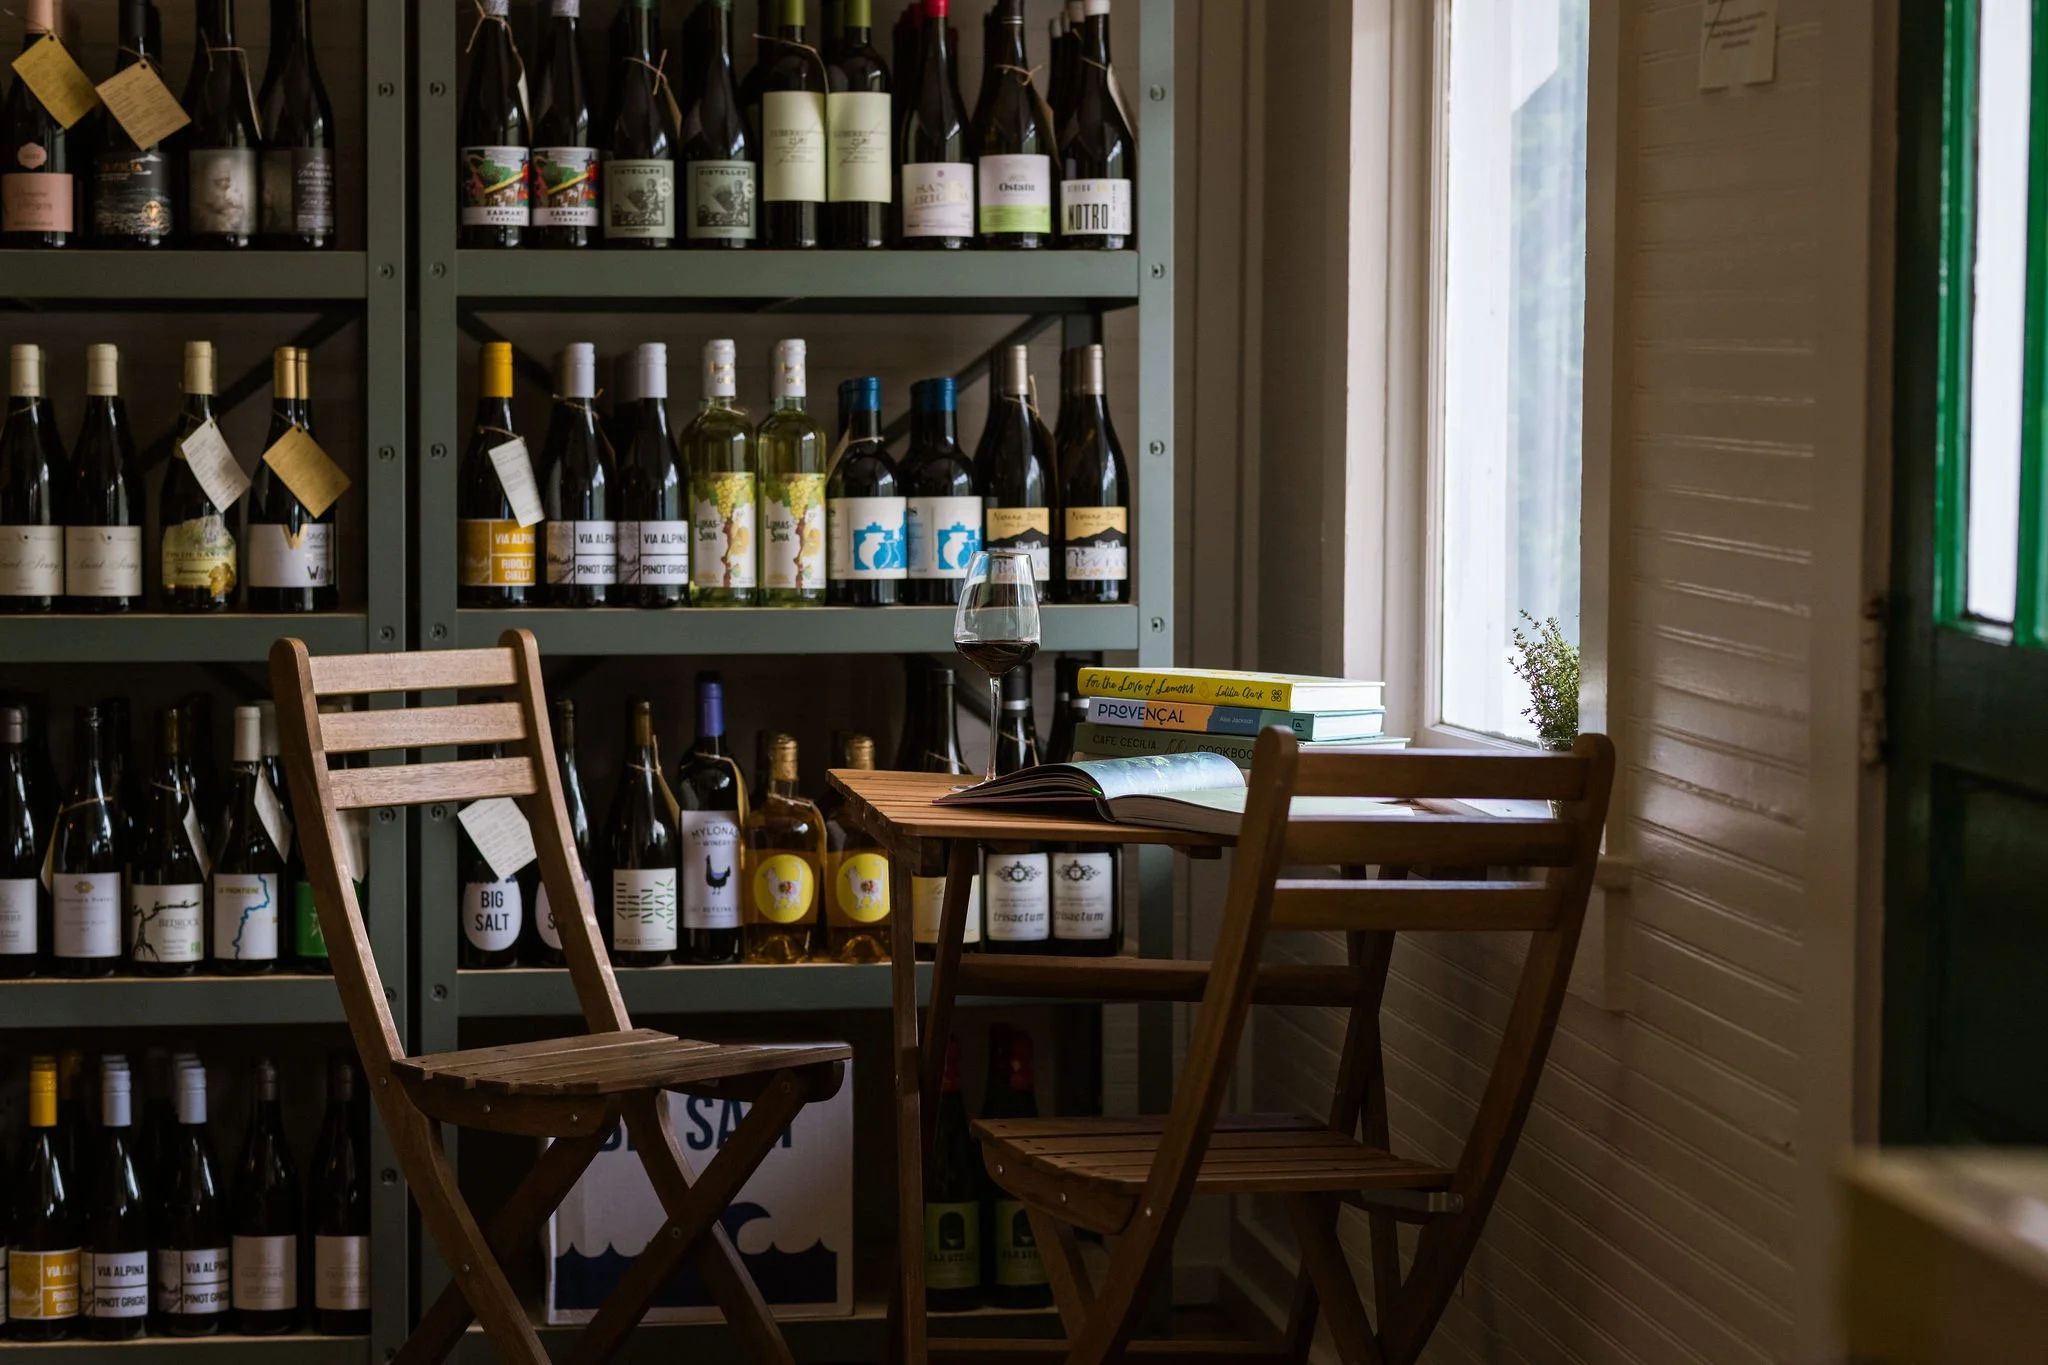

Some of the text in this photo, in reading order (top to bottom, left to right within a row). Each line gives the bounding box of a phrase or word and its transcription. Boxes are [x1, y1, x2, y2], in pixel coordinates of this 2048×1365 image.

[1068, 204, 1108, 230] NOTRO
[495, 533, 536, 544] VIA ALPIN
[579, 534, 592, 544] VIA
[644, 534, 686, 544] VIA ALPIN
[578, 564, 600, 574] PINOT
[642, 564, 666, 575] PINOT
[1102, 676, 1116, 689] the
[1118, 676, 1144, 692] Love
[1145, 678, 1156, 696] of
[1156, 678, 1194, 694] Lemons
[1242, 686, 1264, 700] Clark
[1098, 703, 1185, 726] PROVENÇAL
[1092, 734, 1254, 760] CAFE CECILIA COOKBOO
[480, 890, 504, 909] BIG
[474, 913, 510, 932] SALT
[97, 1264, 144, 1278] VIA ALPINA
[186, 1260, 228, 1274] VIA ALPIN
[96, 1298, 120, 1308] PINOT
[184, 1293, 209, 1304] PINOT
